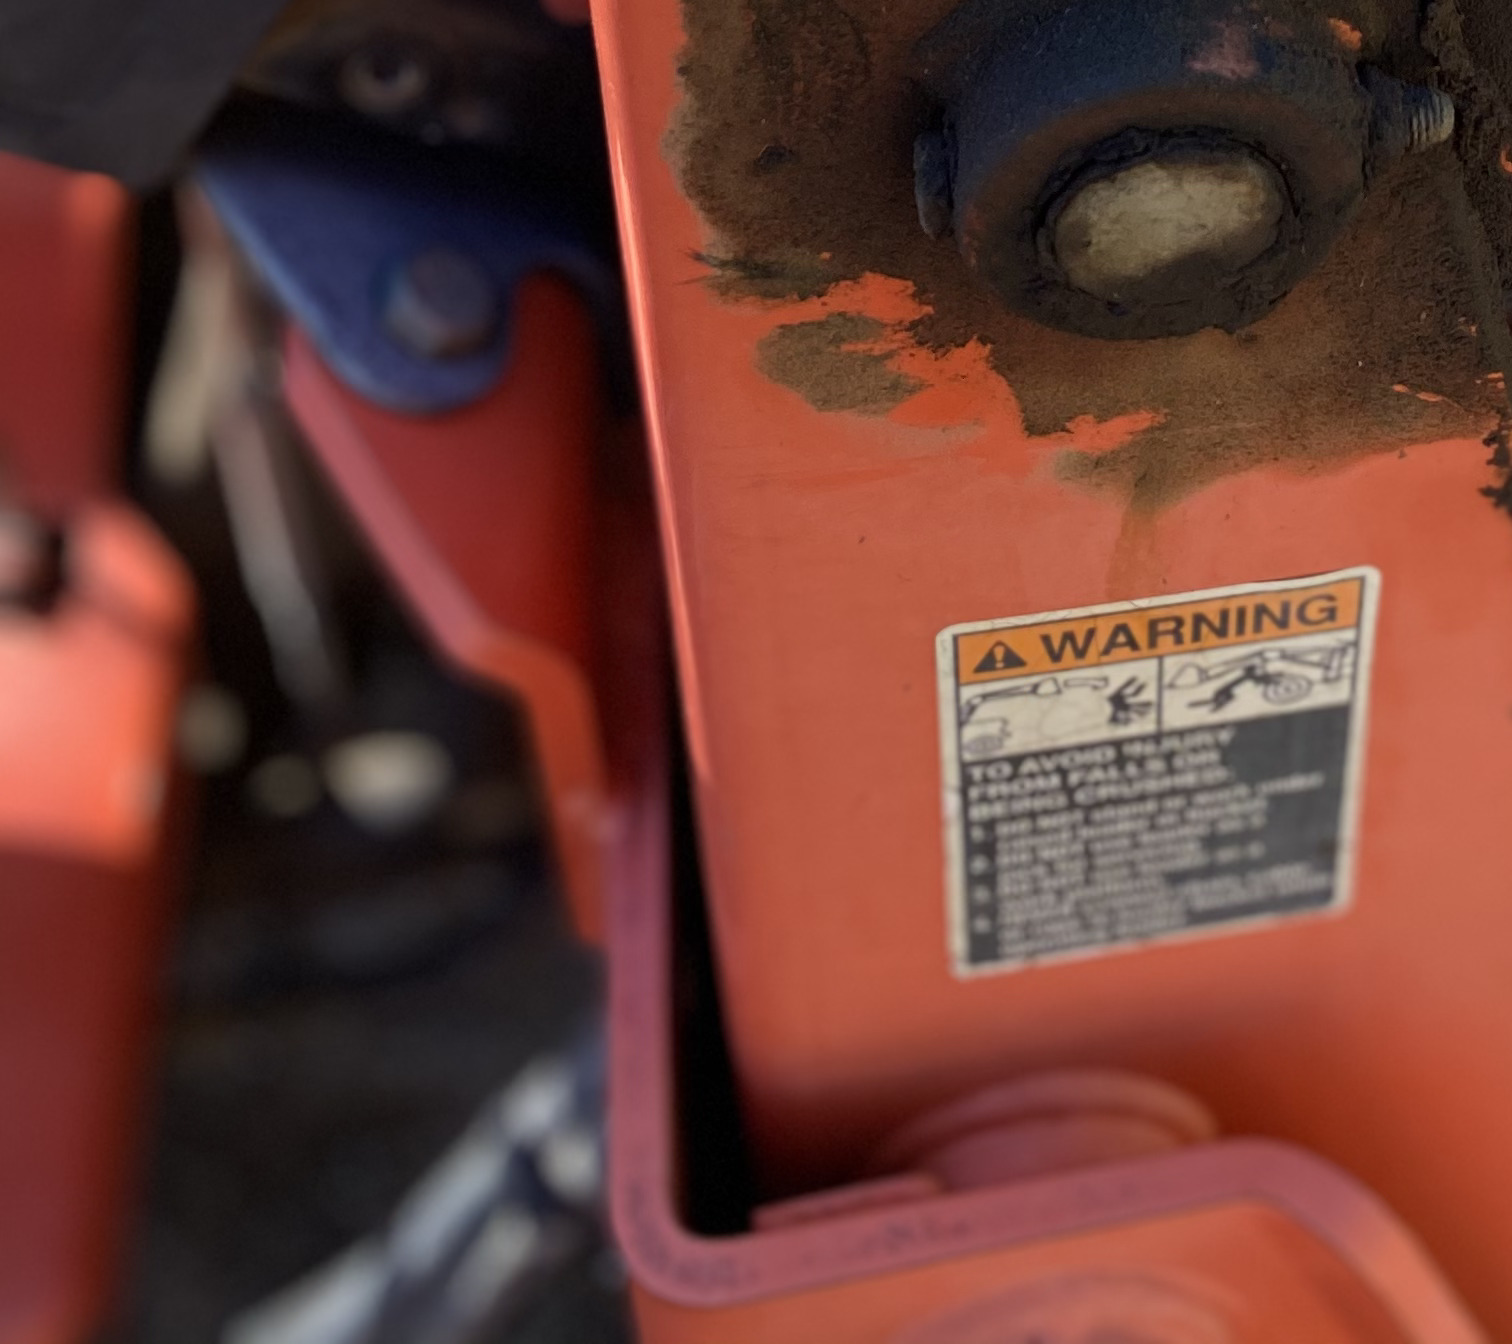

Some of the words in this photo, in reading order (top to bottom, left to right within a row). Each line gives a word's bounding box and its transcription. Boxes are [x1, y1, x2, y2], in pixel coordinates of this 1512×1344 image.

[1040, 593, 1339, 663] WARNING
[968, 759, 1012, 783] TO
[1019, 744, 1115, 775] AVOID
[968, 772, 1061, 801] FROM
[1067, 756, 1166, 787] FALLS
[1173, 748, 1220, 770] OR
[968, 789, 1067, 821] BEING
